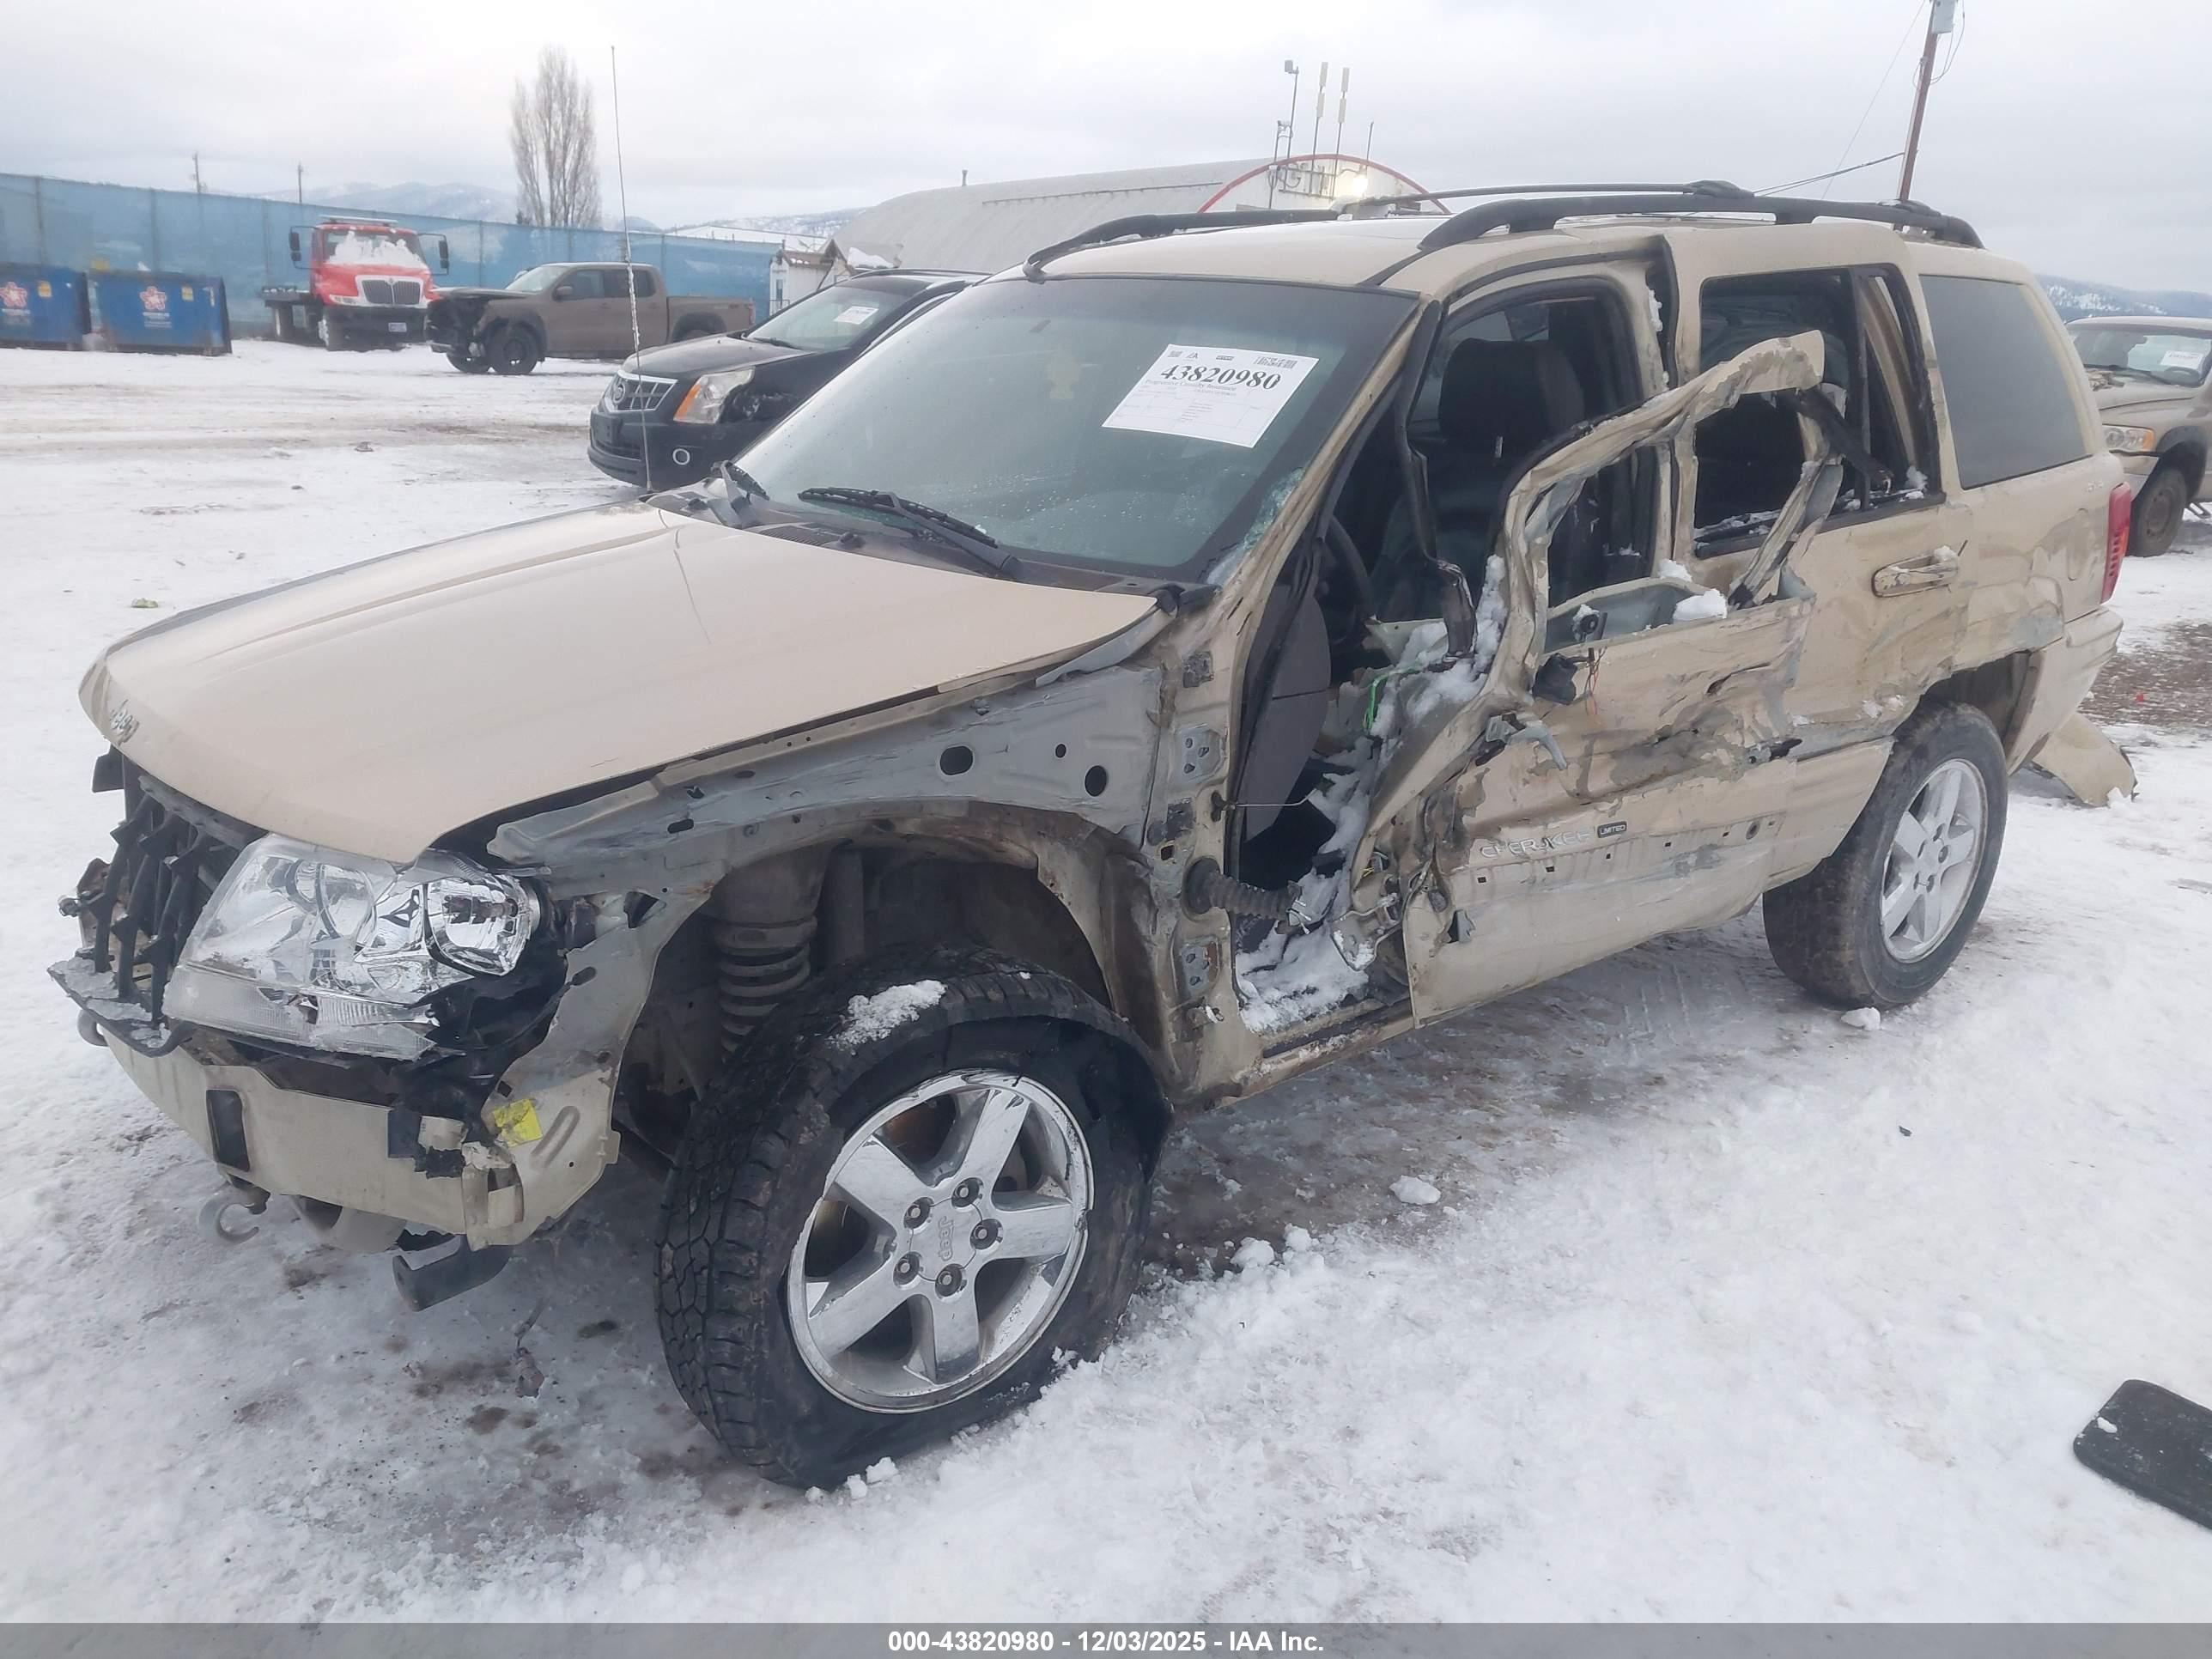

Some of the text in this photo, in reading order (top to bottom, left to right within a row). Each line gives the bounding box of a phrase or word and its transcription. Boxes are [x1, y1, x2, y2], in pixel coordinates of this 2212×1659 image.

[1160, 364, 1282, 390] 43820980
[1600, 824, 1626, 835] LIMITED
[938, 1216, 954, 1261] Jeep
